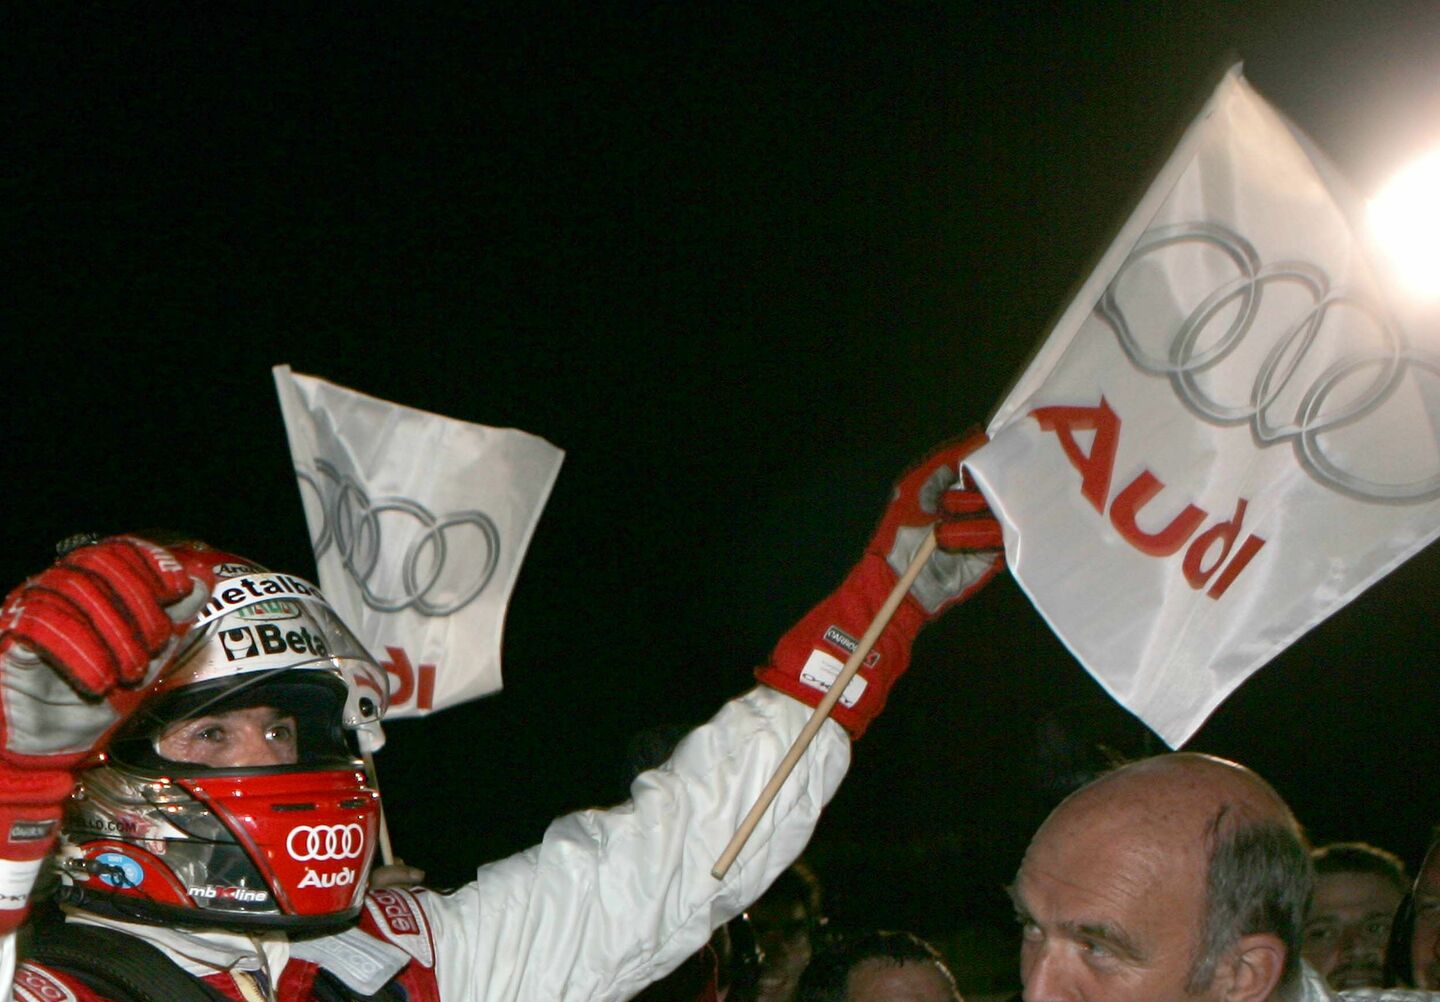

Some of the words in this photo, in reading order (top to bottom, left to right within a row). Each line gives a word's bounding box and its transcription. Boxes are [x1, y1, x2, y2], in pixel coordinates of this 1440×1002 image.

[1027, 394, 1266, 601] Audi
[255, 623, 328, 658] Beta
[297, 867, 355, 889] Audi
